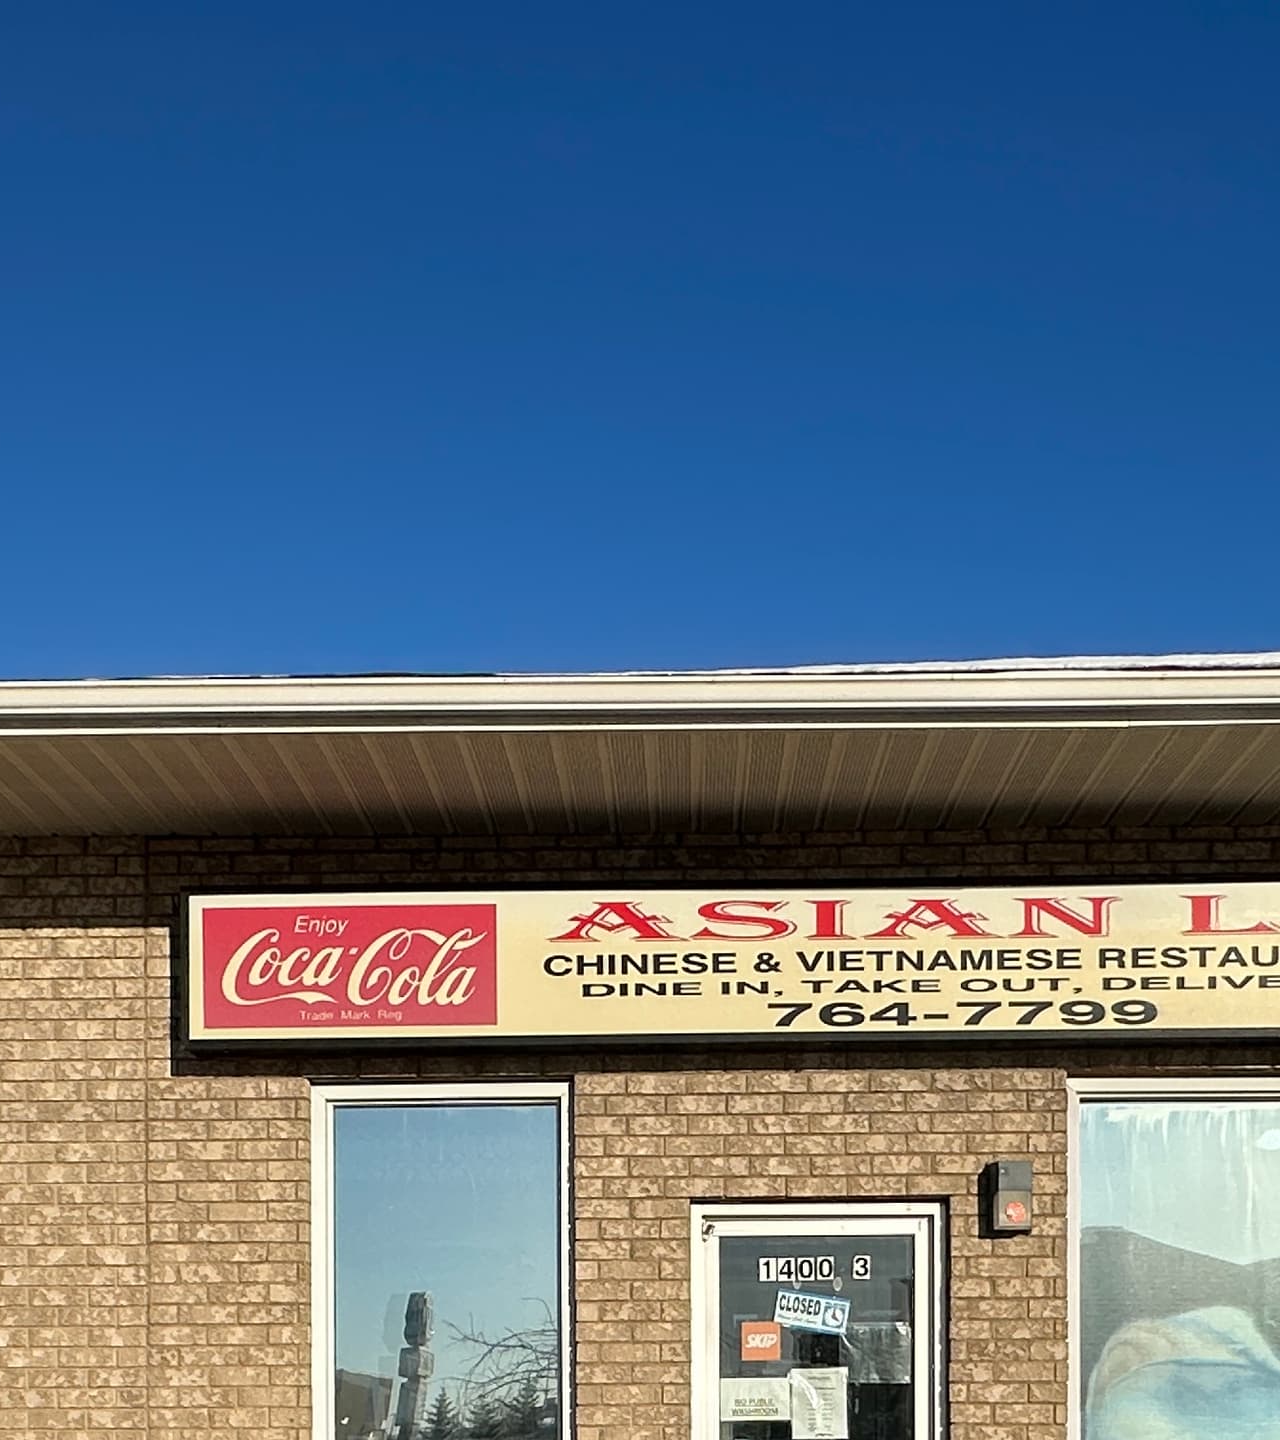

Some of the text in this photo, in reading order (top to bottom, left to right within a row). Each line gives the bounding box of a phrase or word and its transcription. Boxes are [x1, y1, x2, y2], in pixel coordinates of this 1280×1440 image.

[294, 915, 349, 936] Enjoy
[545, 896, 1113, 942] ASIAN
[221, 927, 488, 1006] Coca-Cola
[543, 952, 738, 977] CHINESE
[753, 952, 783, 974] &
[795, 949, 1083, 973] VIETNAMESE
[581, 982, 703, 998] DINE
[721, 981, 783, 998] IN,
[800, 979, 941, 994] TAKE
[960, 978, 1083, 994] OUT,
[340, 1010, 370, 1020] Mark
[767, 1000, 1159, 1027] 764-7799
[761, 1256, 870, 1280] 1400 3
[779, 1294, 821, 1317] CLOSED
[745, 1333, 778, 1349] SKIP
